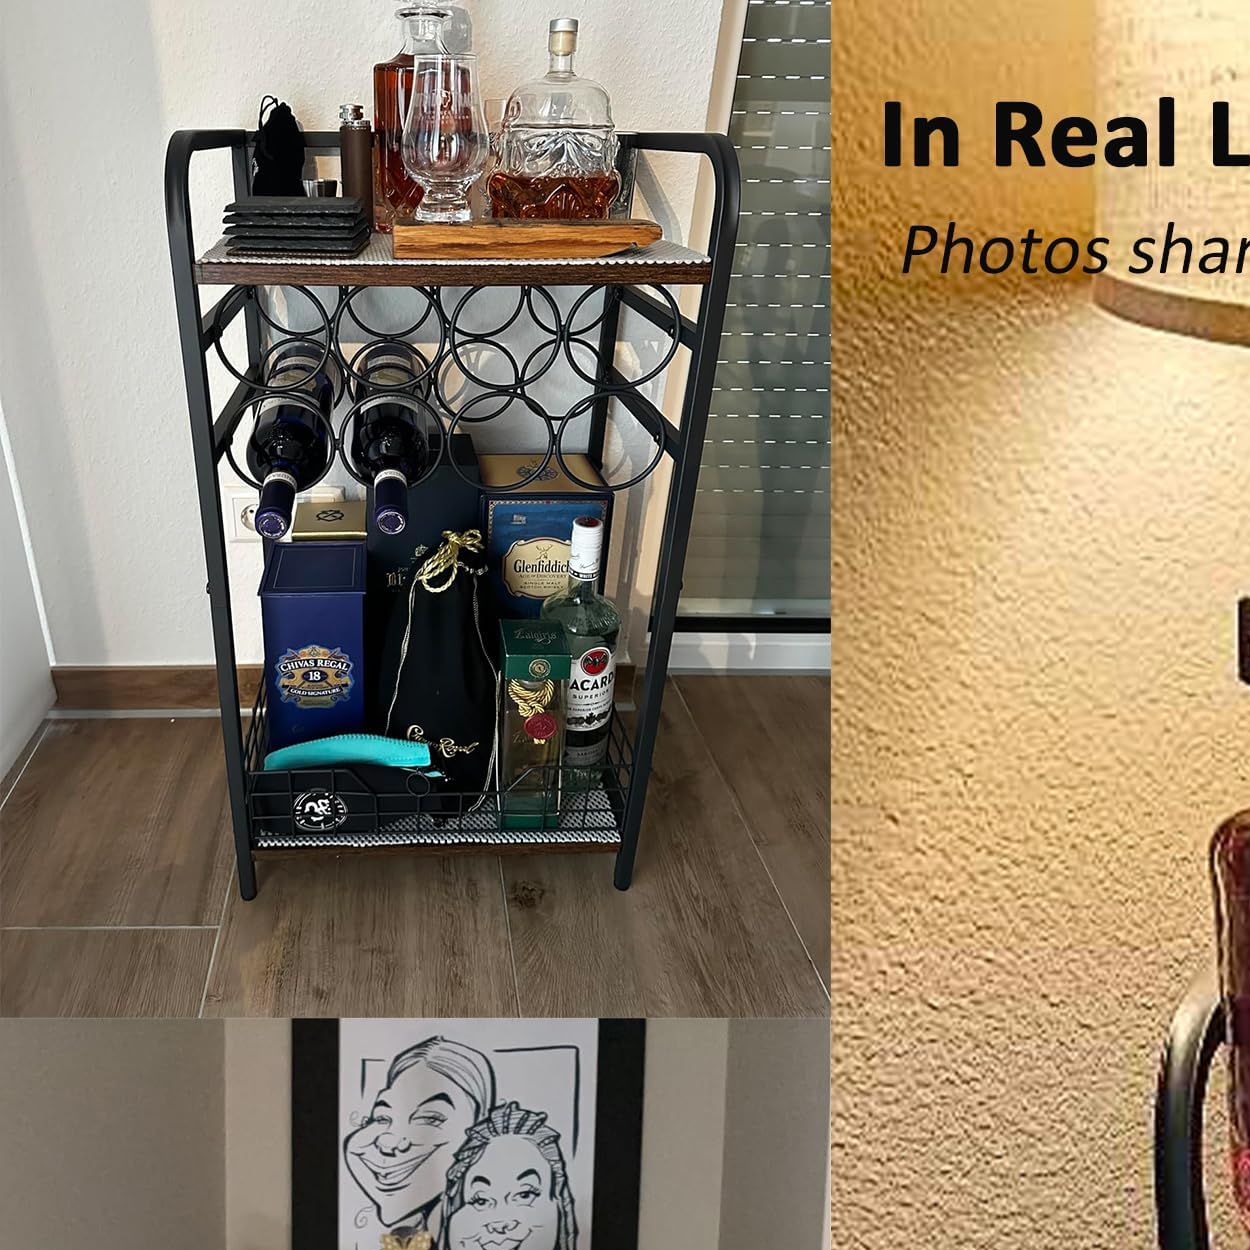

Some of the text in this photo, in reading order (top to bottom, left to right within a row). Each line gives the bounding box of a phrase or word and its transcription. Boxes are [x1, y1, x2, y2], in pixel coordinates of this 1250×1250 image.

[280, 659, 349, 672] CHIVAS REGAL
[308, 671, 321, 681] 18
[569, 671, 614, 692] ACARD
